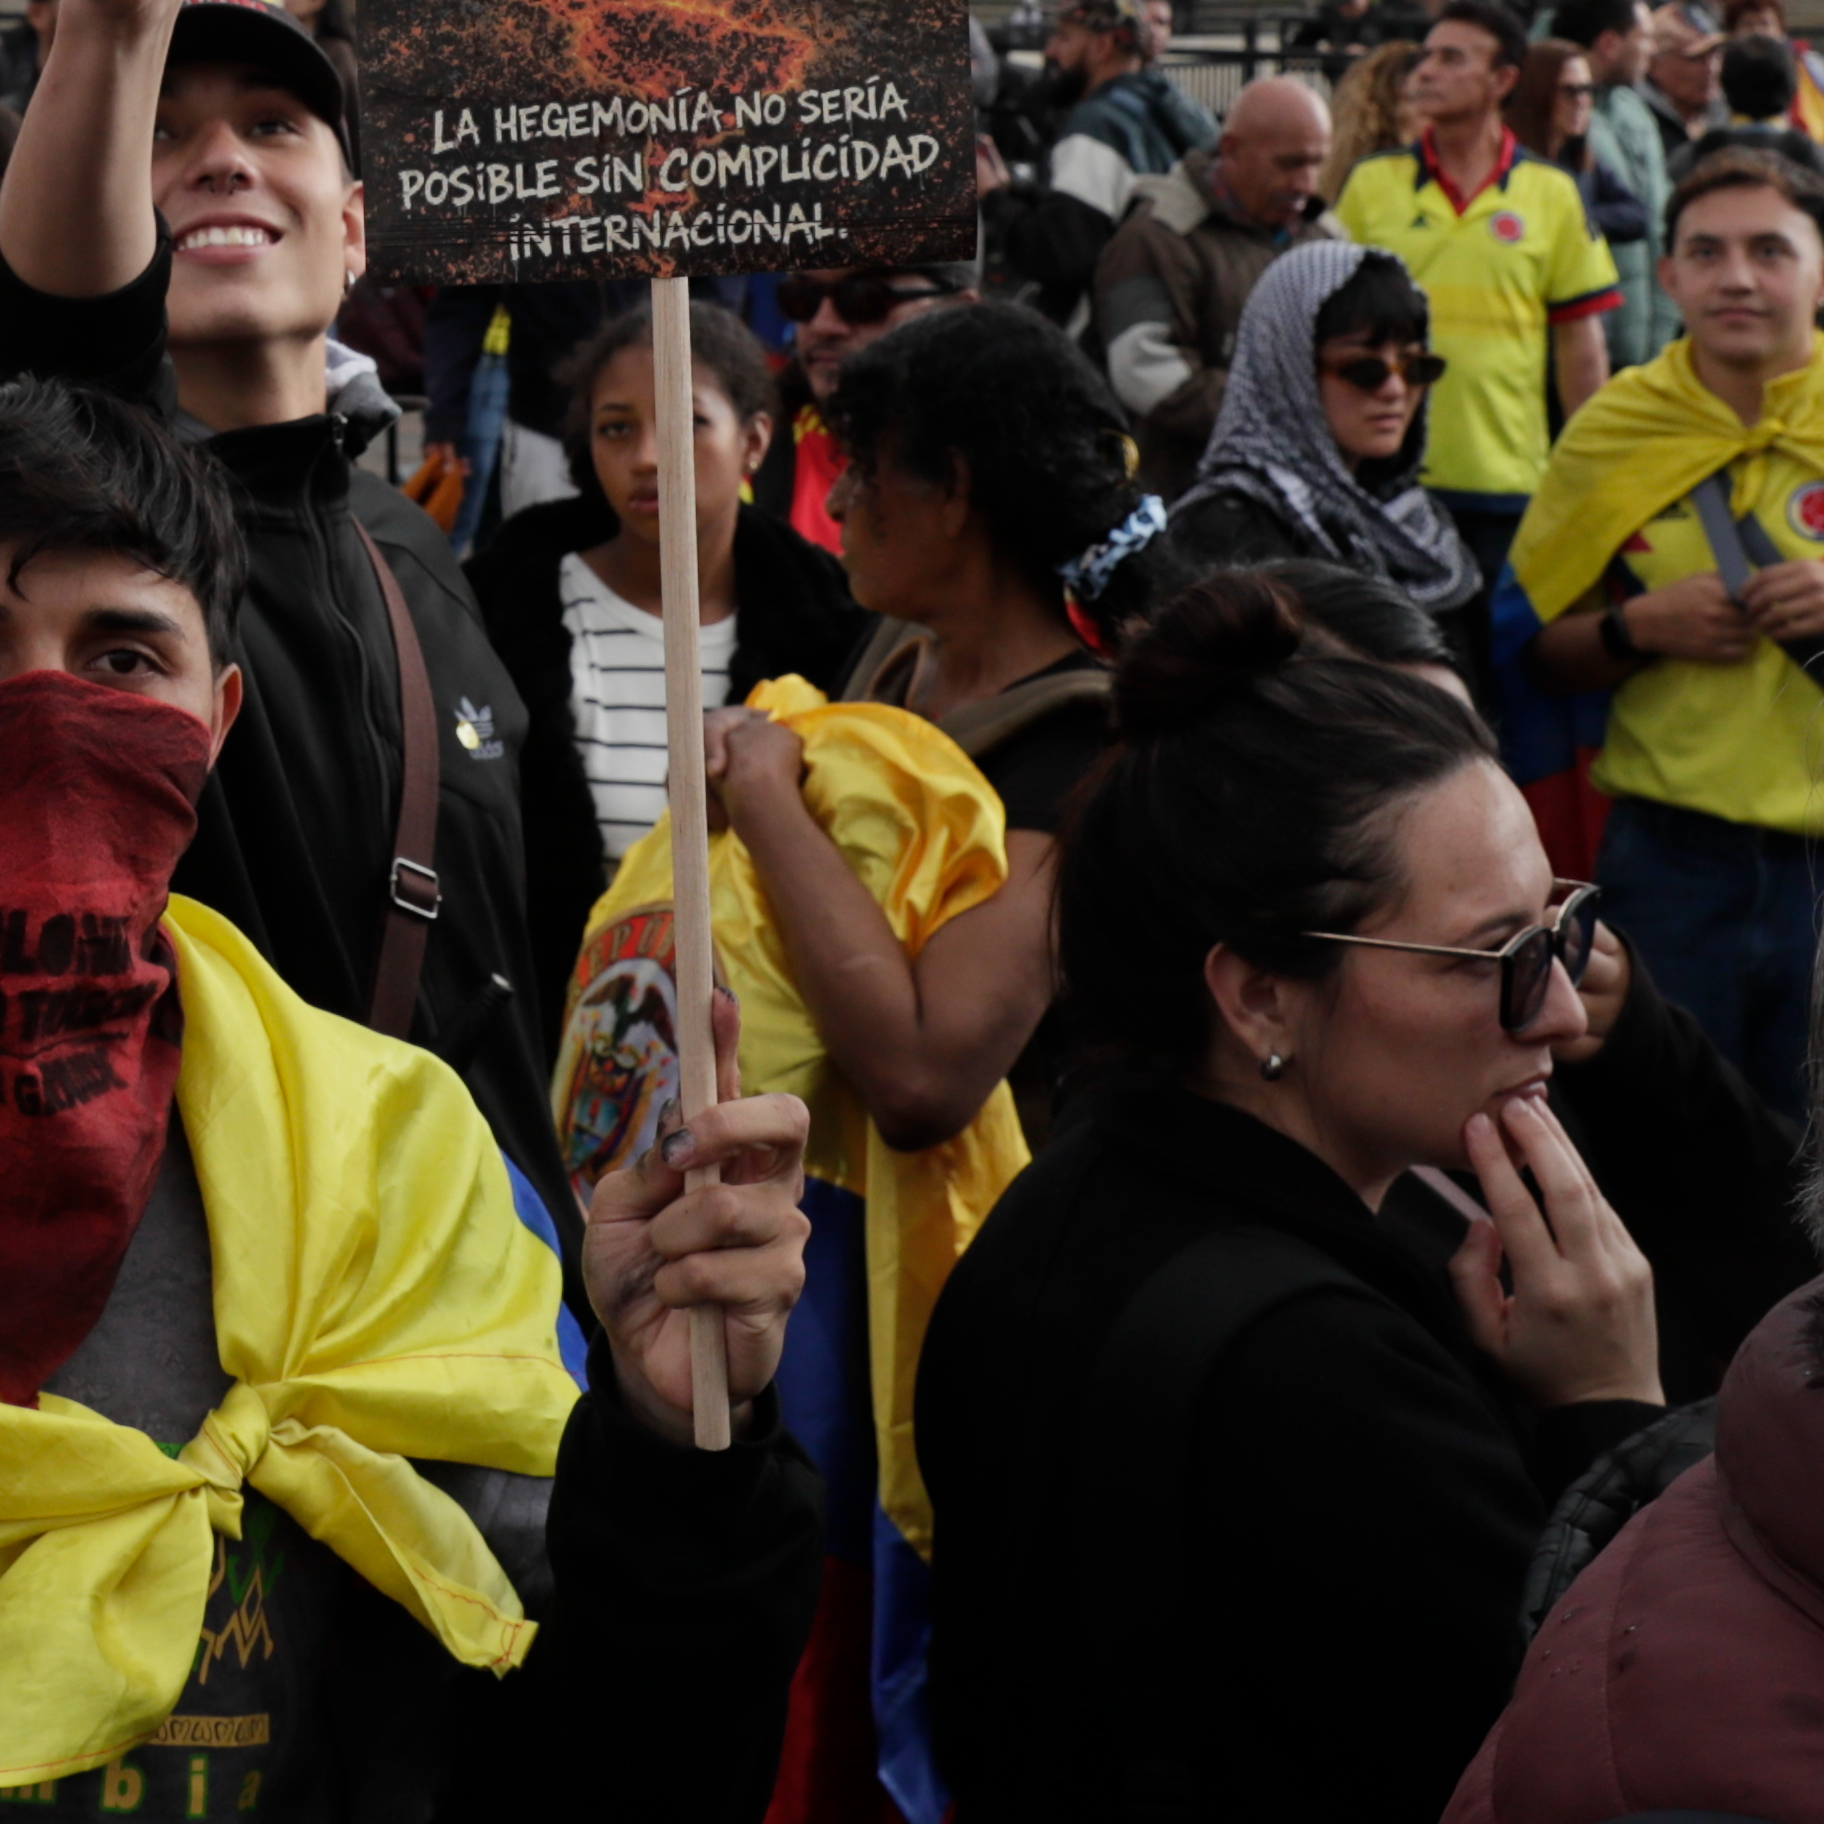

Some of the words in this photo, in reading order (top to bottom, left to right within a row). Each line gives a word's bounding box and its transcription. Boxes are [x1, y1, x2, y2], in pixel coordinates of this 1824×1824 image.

[431, 111, 480, 154] LA
[494, 88, 723, 145] HEGEMONÍA
[735, 91, 786, 130] NO
[798, 77, 908, 126] SERÍA
